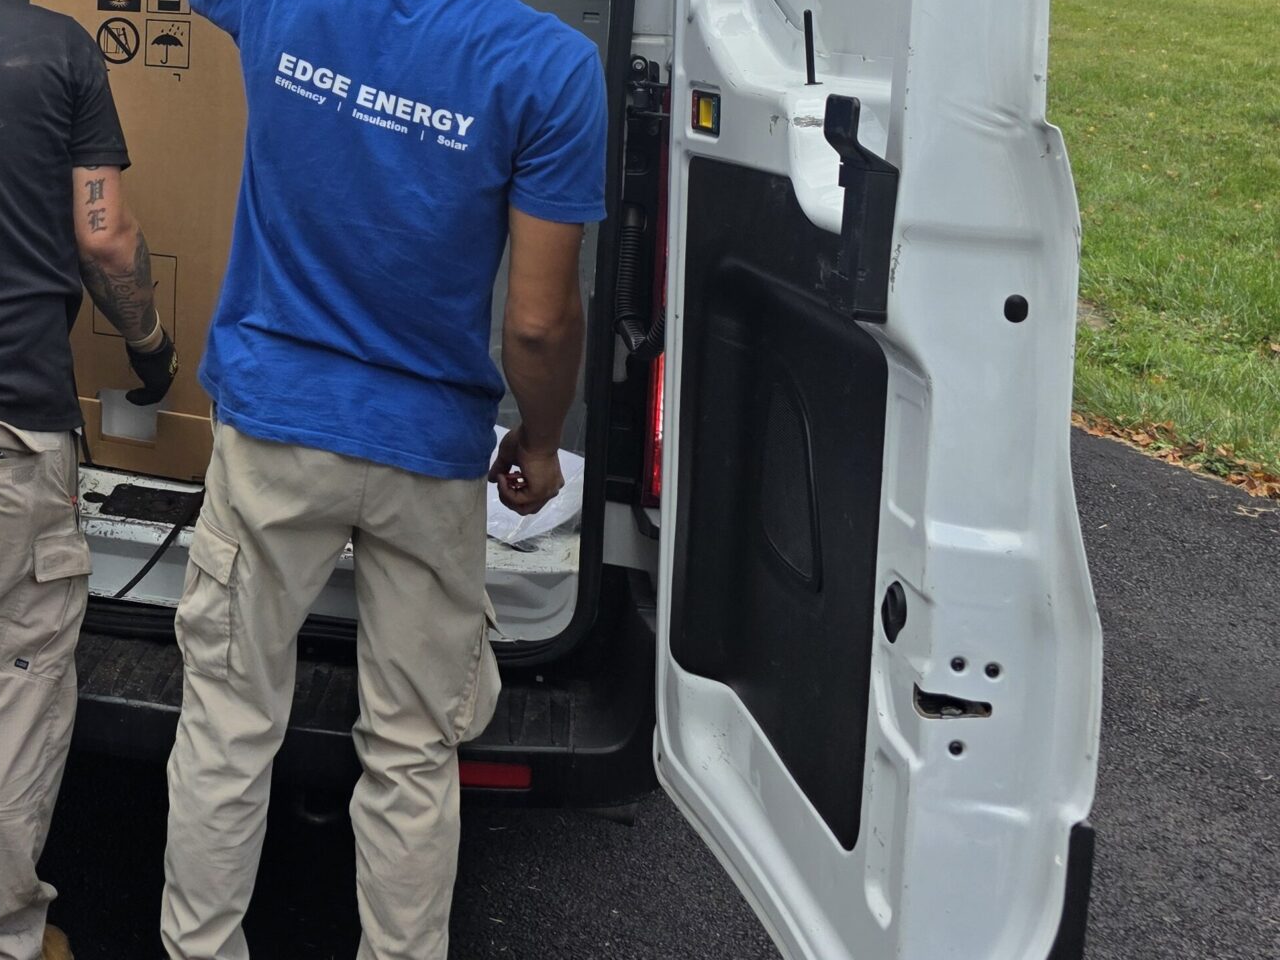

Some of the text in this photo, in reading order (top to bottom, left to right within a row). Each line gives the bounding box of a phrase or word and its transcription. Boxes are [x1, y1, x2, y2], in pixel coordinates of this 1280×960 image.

[275, 75, 469, 152] Efficiency Insulation Solar
[278, 52, 475, 137] EDGE ENERGY
